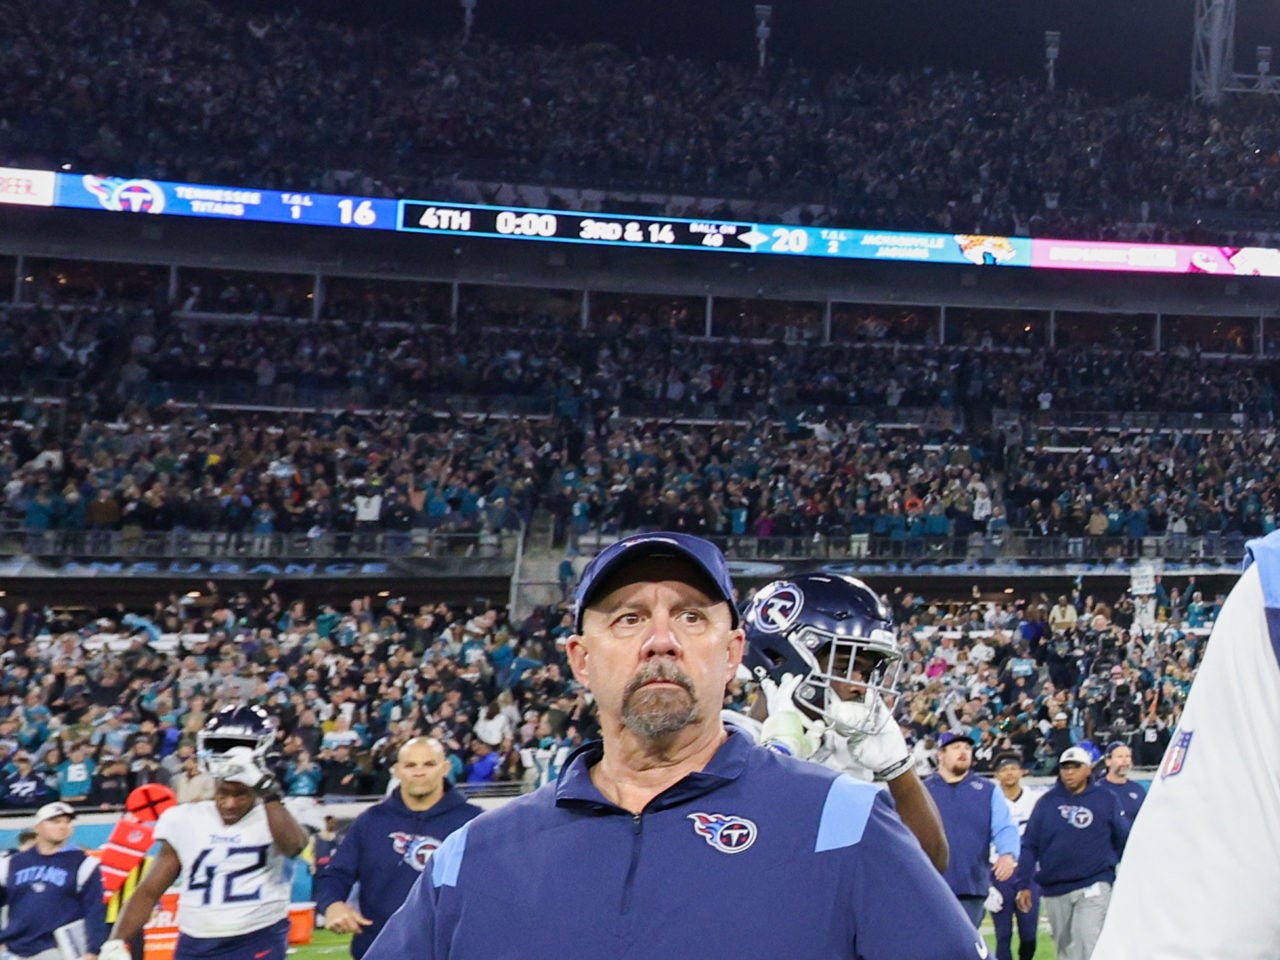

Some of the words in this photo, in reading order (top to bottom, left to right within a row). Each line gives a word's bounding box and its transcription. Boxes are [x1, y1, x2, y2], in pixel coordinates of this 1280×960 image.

[190, 200, 244, 216] TITANS
[290, 205, 301, 219] 1
[338, 200, 376, 226] 16
[419, 207, 471, 231] 4TH
[496, 212, 557, 237] 0:00
[579, 218, 623, 241] 3RD
[624, 221, 643, 242] &
[648, 223, 675, 244] 14
[771, 227, 808, 253] 20
[827, 240, 839, 253] 2
[15, 865, 69, 887] TITANS
[188, 843, 273, 906] 42
